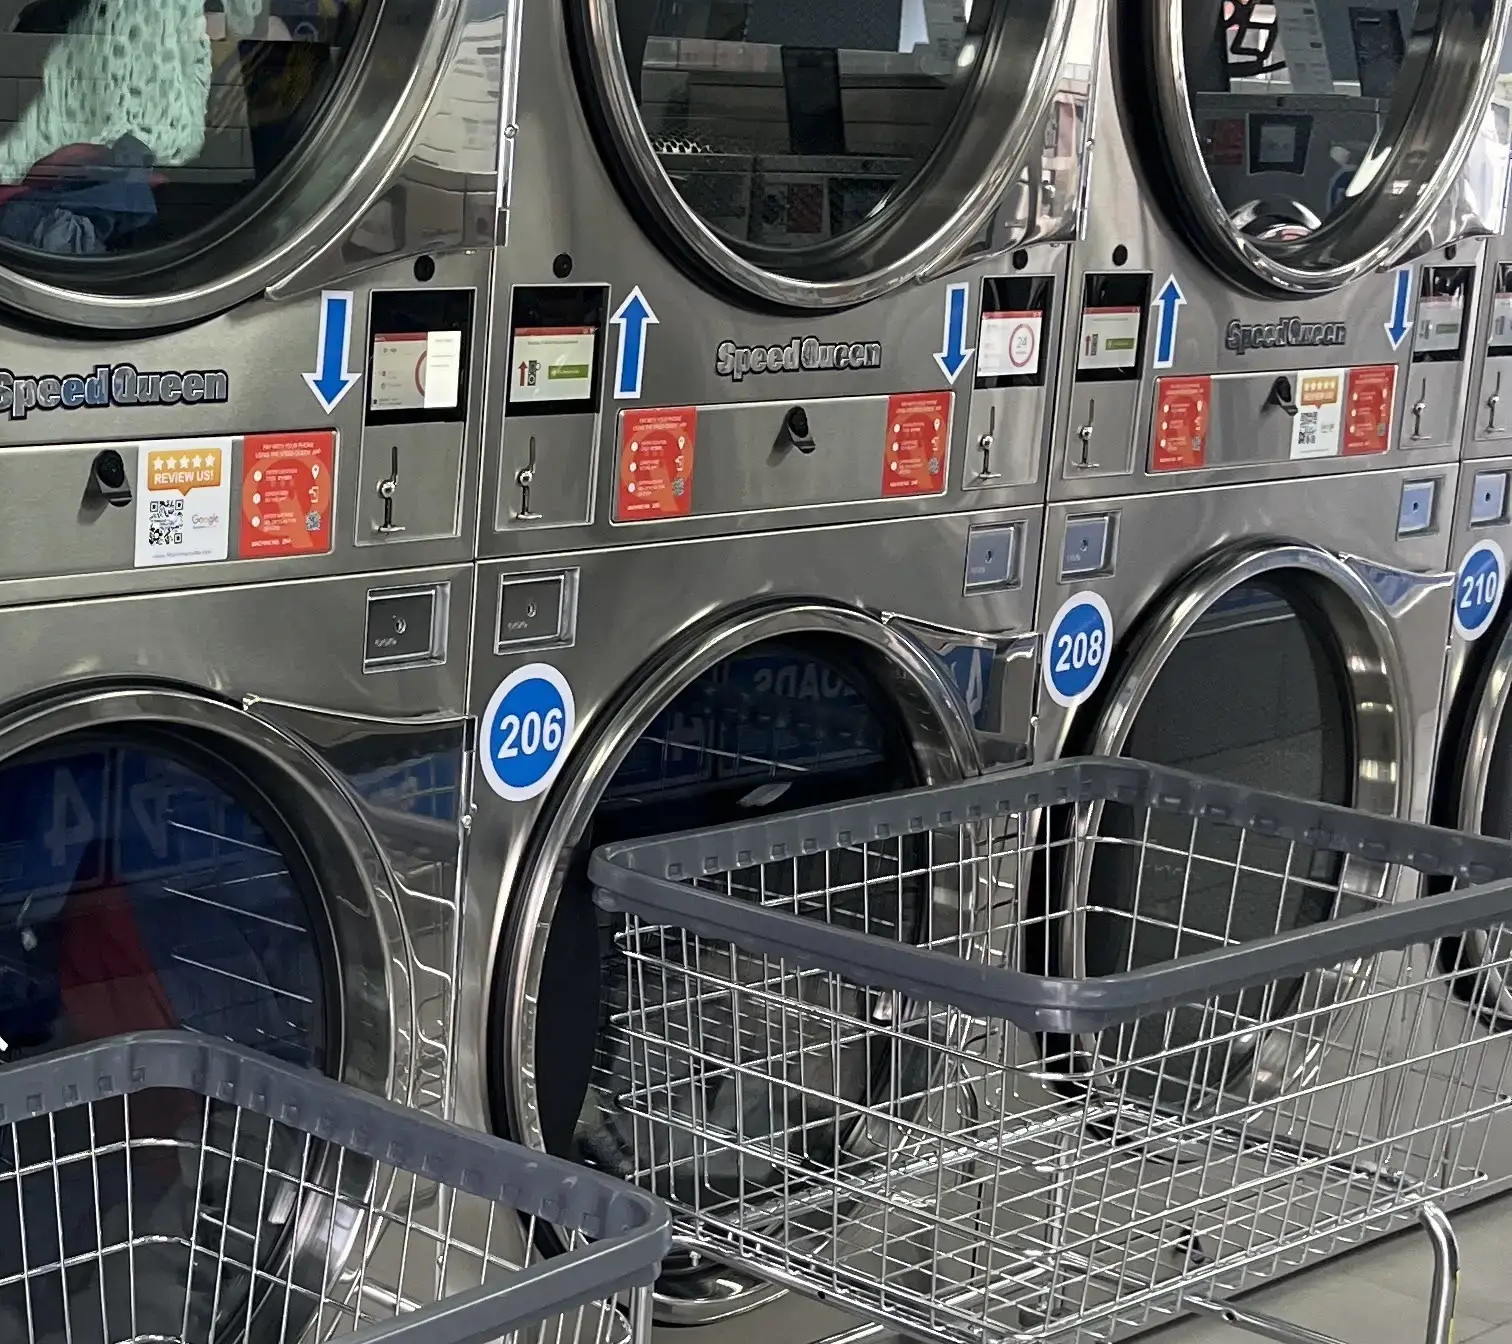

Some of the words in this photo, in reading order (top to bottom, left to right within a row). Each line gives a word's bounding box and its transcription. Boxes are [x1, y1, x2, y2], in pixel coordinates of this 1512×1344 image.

[154, 470, 194, 485] REVIEW
[196, 469, 214, 482] US!
[191, 513, 219, 526] Google
[1459, 575, 1496, 609] 210
[1055, 629, 1103, 673] 208
[497, 707, 563, 760] 206
